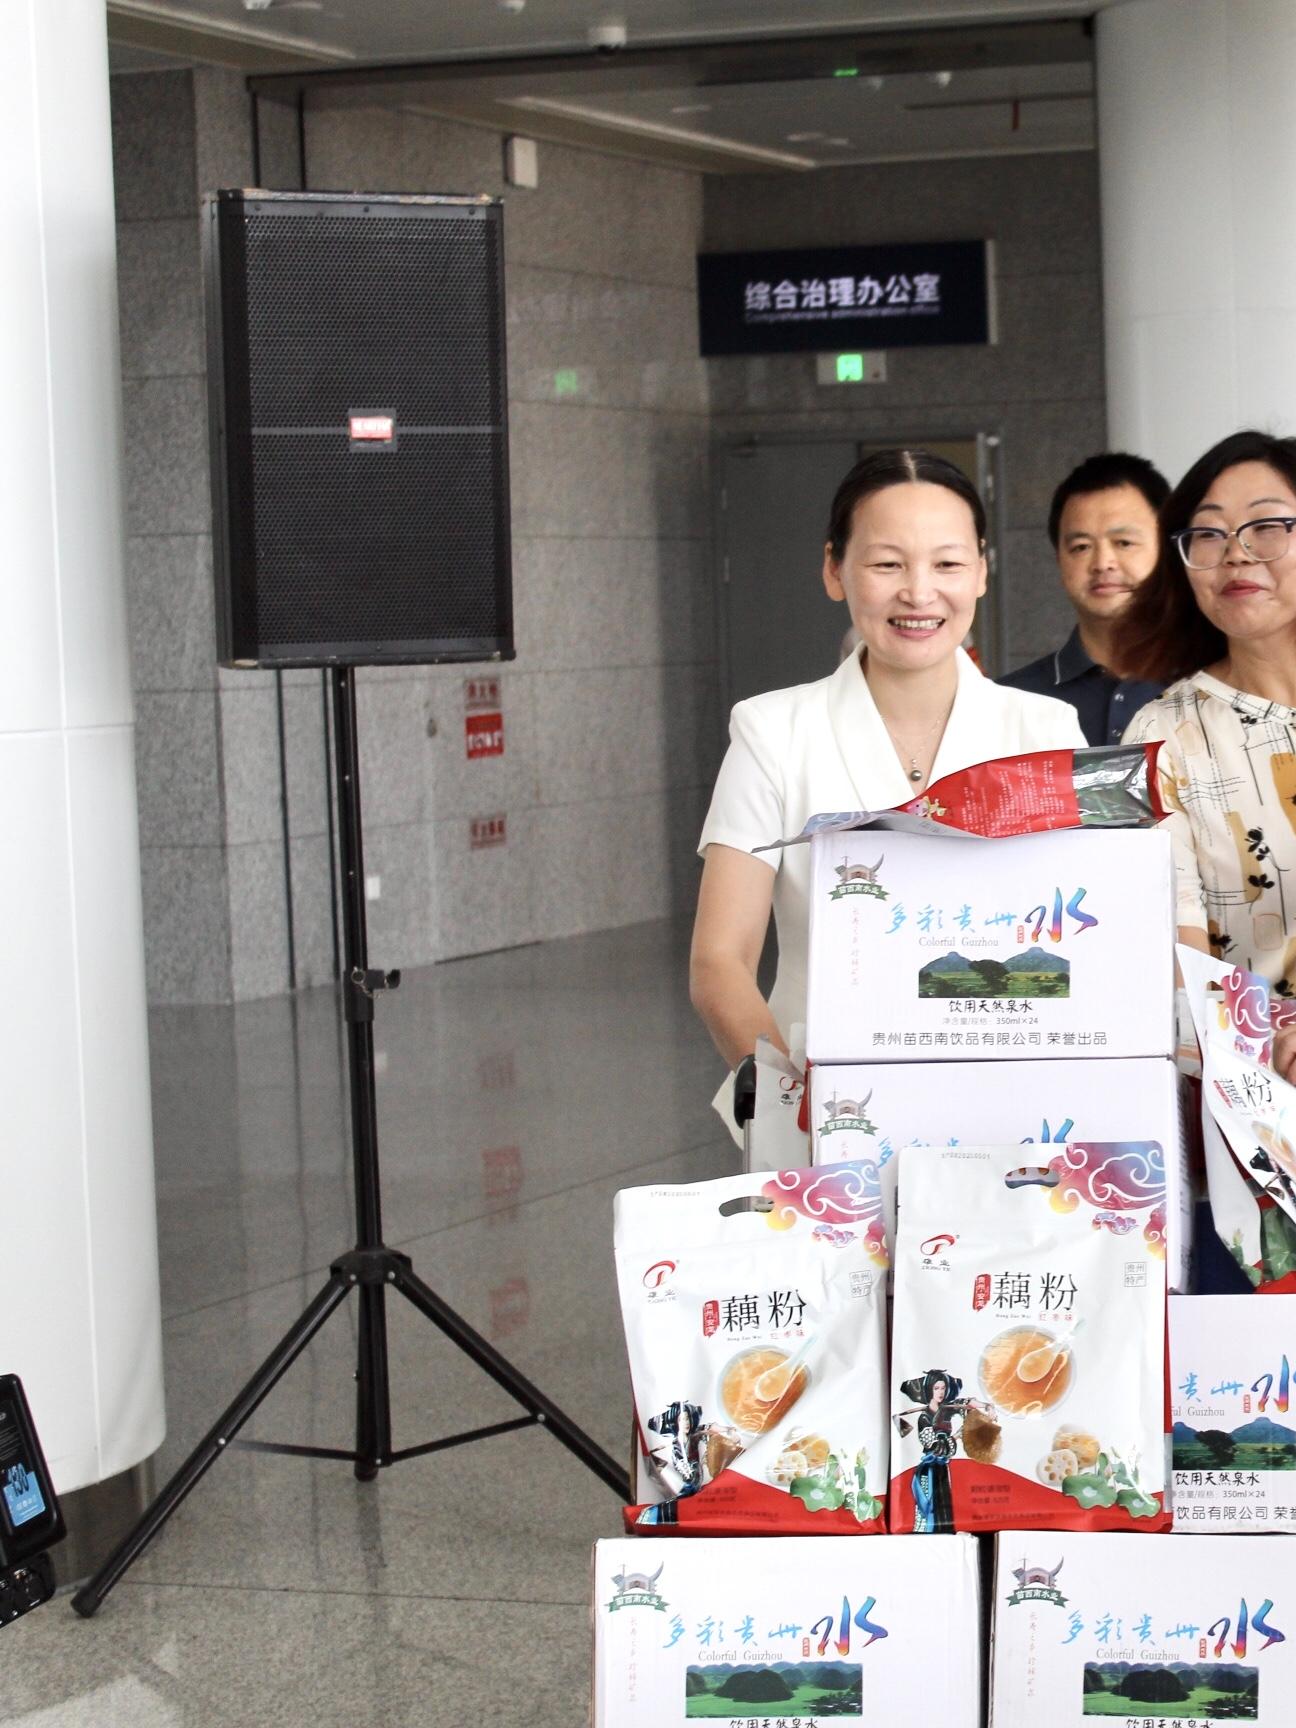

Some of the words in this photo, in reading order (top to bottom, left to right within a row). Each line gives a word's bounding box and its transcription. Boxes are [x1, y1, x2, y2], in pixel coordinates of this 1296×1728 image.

[744, 272, 941, 311] 综合治理办公室
[918, 936, 956, 948] Colorful
[961, 936, 999, 948] Guizhou
[948, 999, 1034, 1014] 饮用天然泉水
[872, 1032, 1042, 1047] 贵州苗西南饮品有限公司
[1047, 1031, 1108, 1046] 荣誉出品
[992, 1271, 1079, 1311] 藕粉
[721, 1289, 808, 1332] 藕粉
[1187, 1406, 1225, 1417] Guizhou
[1174, 1471, 1261, 1487] 饮用天然泉水
[1172, 1505, 1269, 1520] 饮品有限公司
[697, 1650, 738, 1662] Colorful
[743, 1650, 783, 1662] Guizhou
[1095, 1648, 1135, 1660] Colorful
[1140, 1648, 1180, 1661] Guizhou
